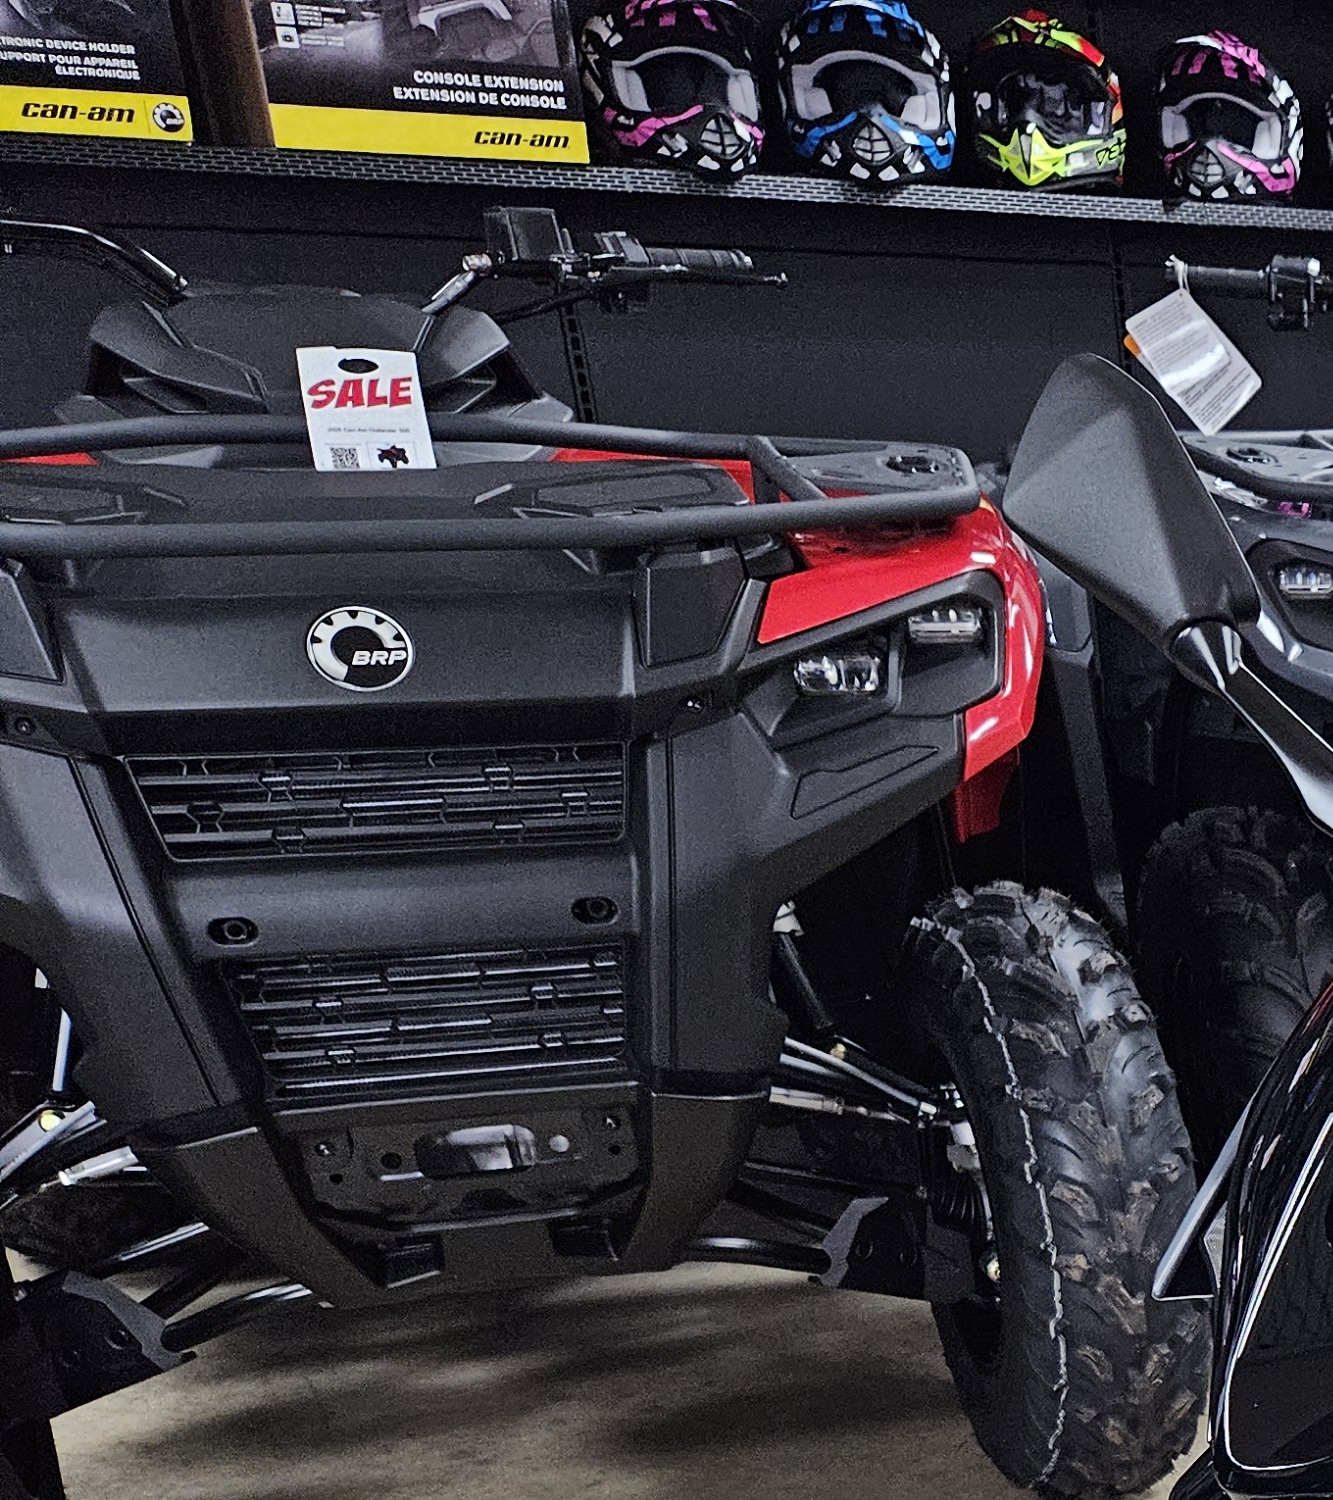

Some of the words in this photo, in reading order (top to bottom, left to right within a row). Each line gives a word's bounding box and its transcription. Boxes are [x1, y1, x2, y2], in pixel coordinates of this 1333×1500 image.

[0, 36, 43, 48] TRONIC
[46, 39, 87, 51] DEVICE
[88, 42, 135, 54] HOLDER
[0, 51, 46, 63] UPPORT
[49, 54, 82, 66] POUR
[83, 56, 139, 69] APPAREIL
[55, 64, 141, 80] ÉLECTRONIQUE
[413, 70, 482, 87] CONSOLE
[484, 75, 565, 93] EXTENSION
[393, 86, 476, 104] EXTENSION
[478, 91, 498, 105] DE
[501, 93, 567, 110] CONSOLE
[22, 102, 135, 123] can-am
[474, 130, 570, 149] can-am
[307, 376, 413, 410] SALE
[352, 650, 407, 666] BRP
